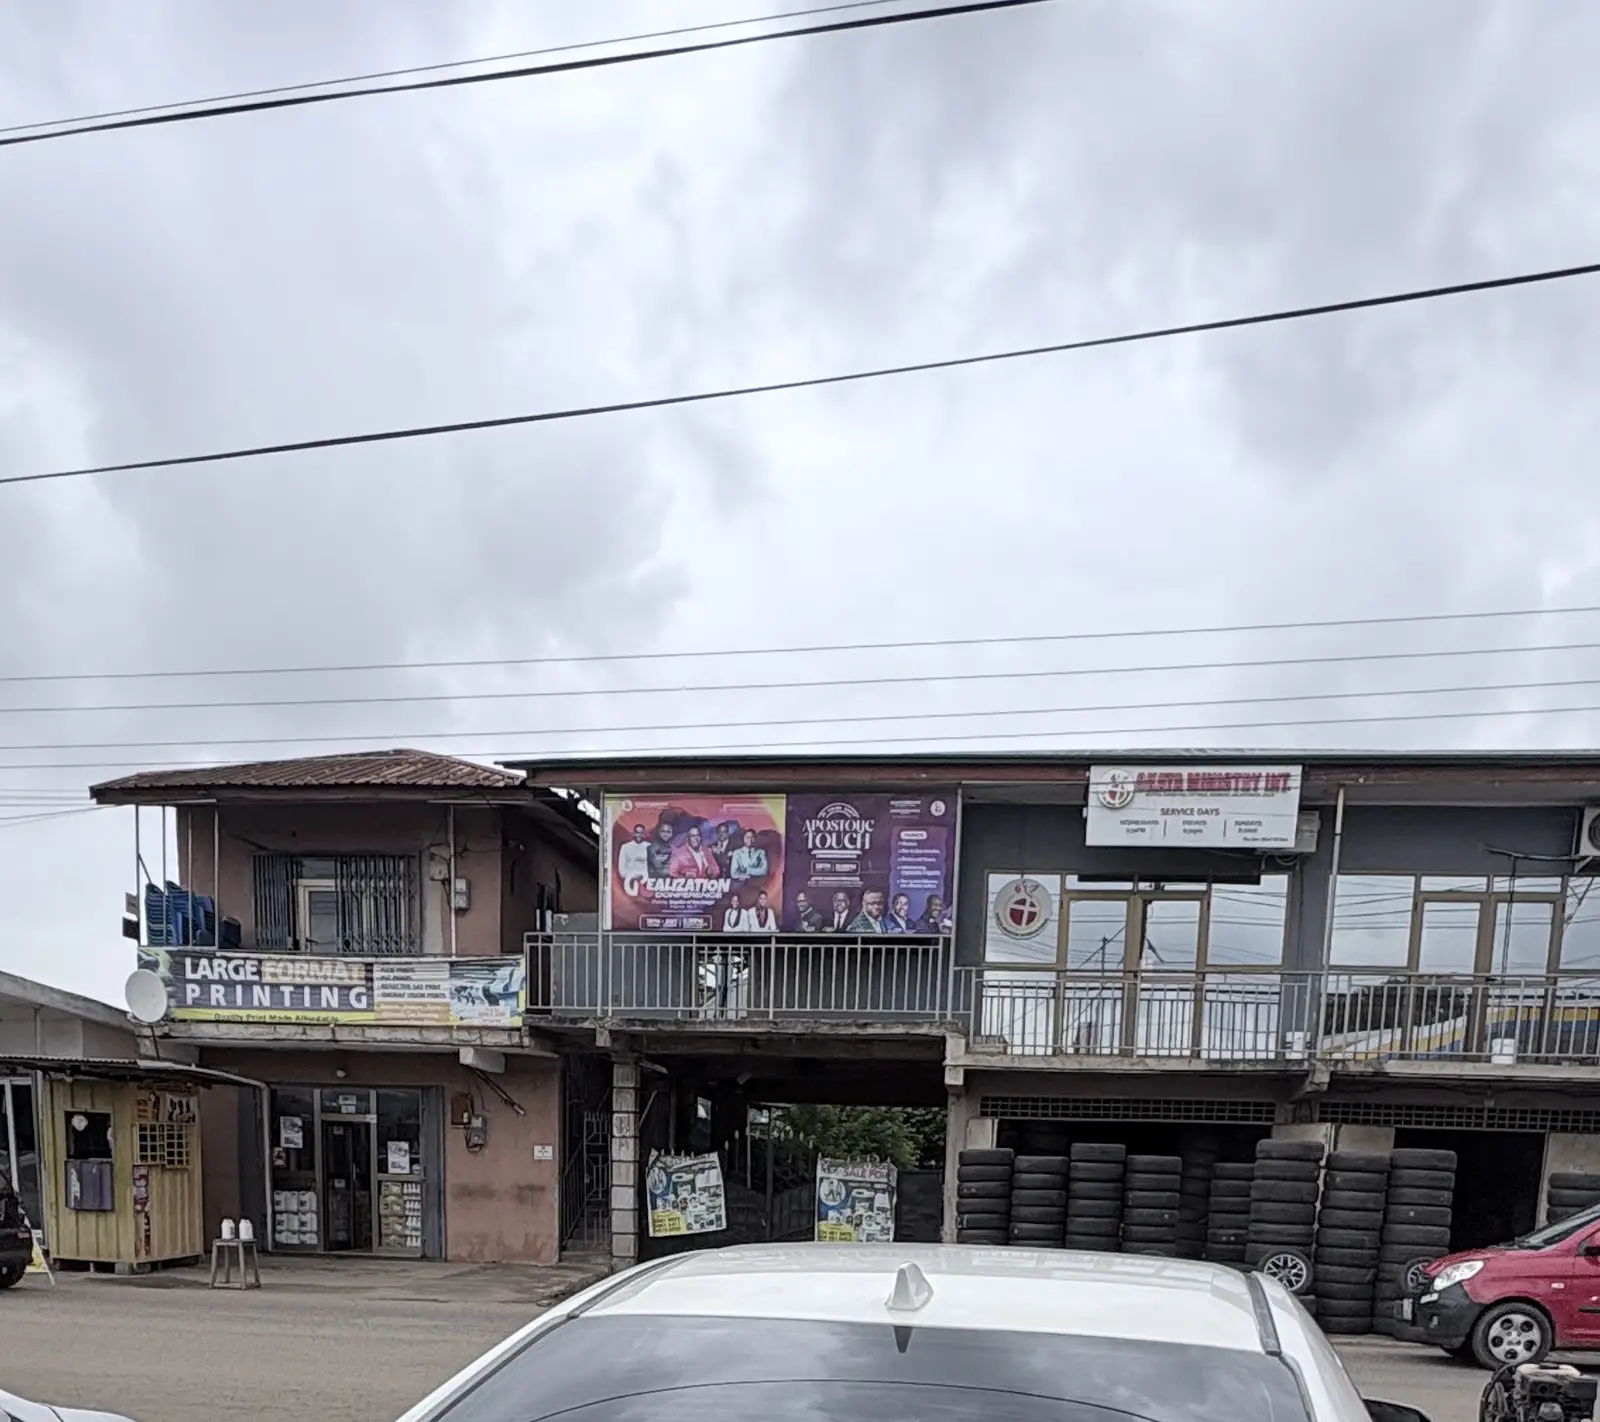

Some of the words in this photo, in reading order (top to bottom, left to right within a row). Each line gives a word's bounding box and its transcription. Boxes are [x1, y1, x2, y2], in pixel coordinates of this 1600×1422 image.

[1160, 807, 1195, 816] SERVICE
[1197, 808, 1220, 817] DAYS
[803, 829, 871, 850] TOUCH
[184, 956, 260, 981] LARGE
[262, 959, 365, 980] FORMAT
[185, 983, 367, 1009] PRINTING
